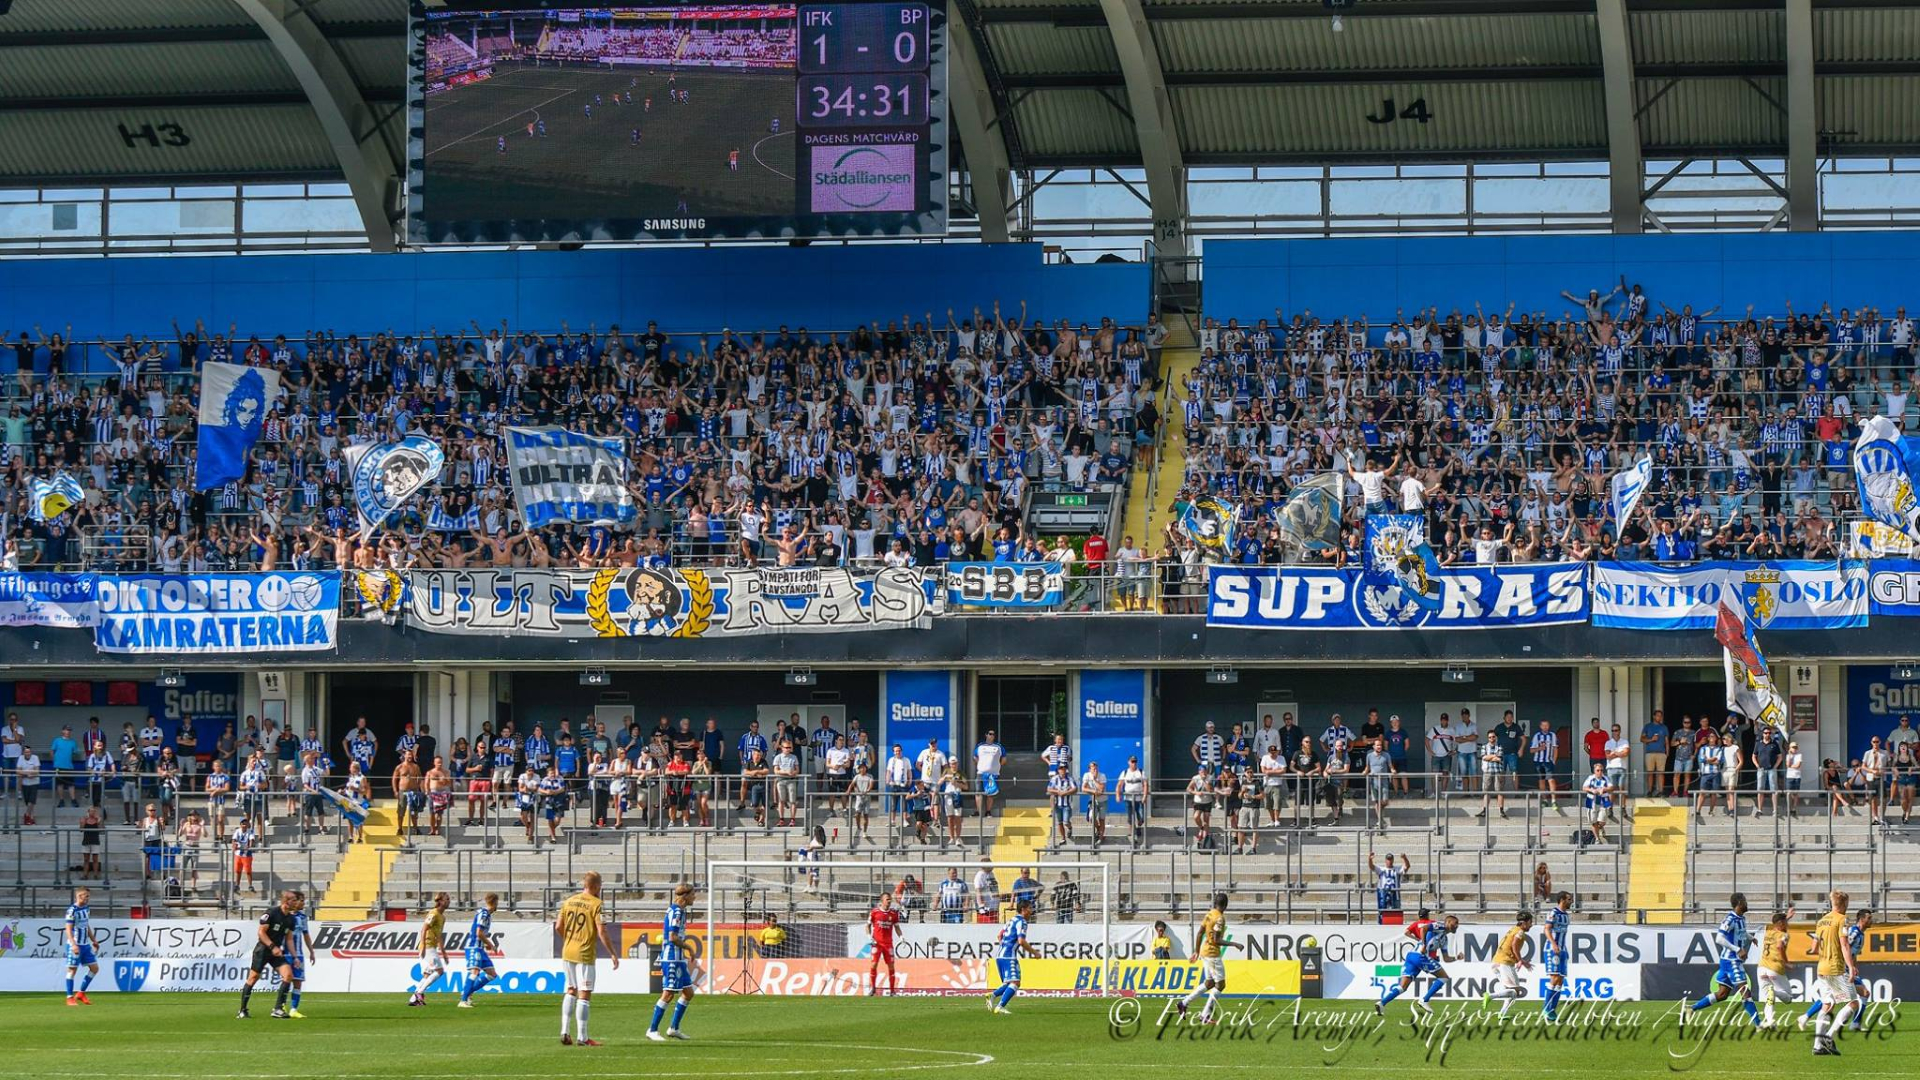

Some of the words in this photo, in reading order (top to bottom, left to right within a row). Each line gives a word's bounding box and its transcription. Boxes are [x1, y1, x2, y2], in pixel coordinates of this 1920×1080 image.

[806, 11, 832, 26] IFK
[901, 9, 923, 24] BP
[813, 33, 826, 64] 1
[894, 31, 916, 63] 0
[811, 84, 910, 117] 34:31
[1366, 98, 1433, 123] J4
[118, 123, 190, 148] H3
[805, 134, 850, 144] DAGENS
[853, 131, 919, 142] MATCHVÄRD
[815, 171, 911, 185] Städalliansen
[644, 218, 706, 230] SAMSUNG
[1157, 219, 1177, 228] H4
[758, 569, 798, 583] SYMPATI
[801, 569, 819, 582] FÖR
[950, 575, 961, 586] 20
[962, 566, 1046, 601] SBB
[1047, 577, 1058, 588] 11
[98, 579, 252, 612] OKTOBER
[411, 570, 571, 631] ULT
[723, 566, 926, 631] RAS
[1212, 575, 1346, 619] SUP
[1437, 569, 1584, 619] RAS
[1779, 577, 1866, 603] OSLO
[99, 614, 329, 648] KAMRATERNA
[165, 677, 177, 685] G3
[589, 675, 601, 683] G4
[795, 675, 807, 683] G5
[165, 689, 238, 719] Sofier
[891, 701, 944, 721] Sofiero
[1086, 700, 1138, 718] Sofiero
[37, 921, 242, 948] STDENTSTÄD
[313, 926, 505, 950] BERGKVAABS
[1870, 933, 1920, 953] HE
[895, 939, 1146, 960] ONEPARNERGROUP
[1464, 932, 1641, 963] MORIS
[118, 966, 127, 979] P
[133, 967, 145, 980] M
[160, 963, 283, 985] ProfilMonag
[407, 963, 566, 992] Swgo
[759, 961, 908, 994] Renova
[1075, 962, 1206, 990] BLÅKLÄDE
